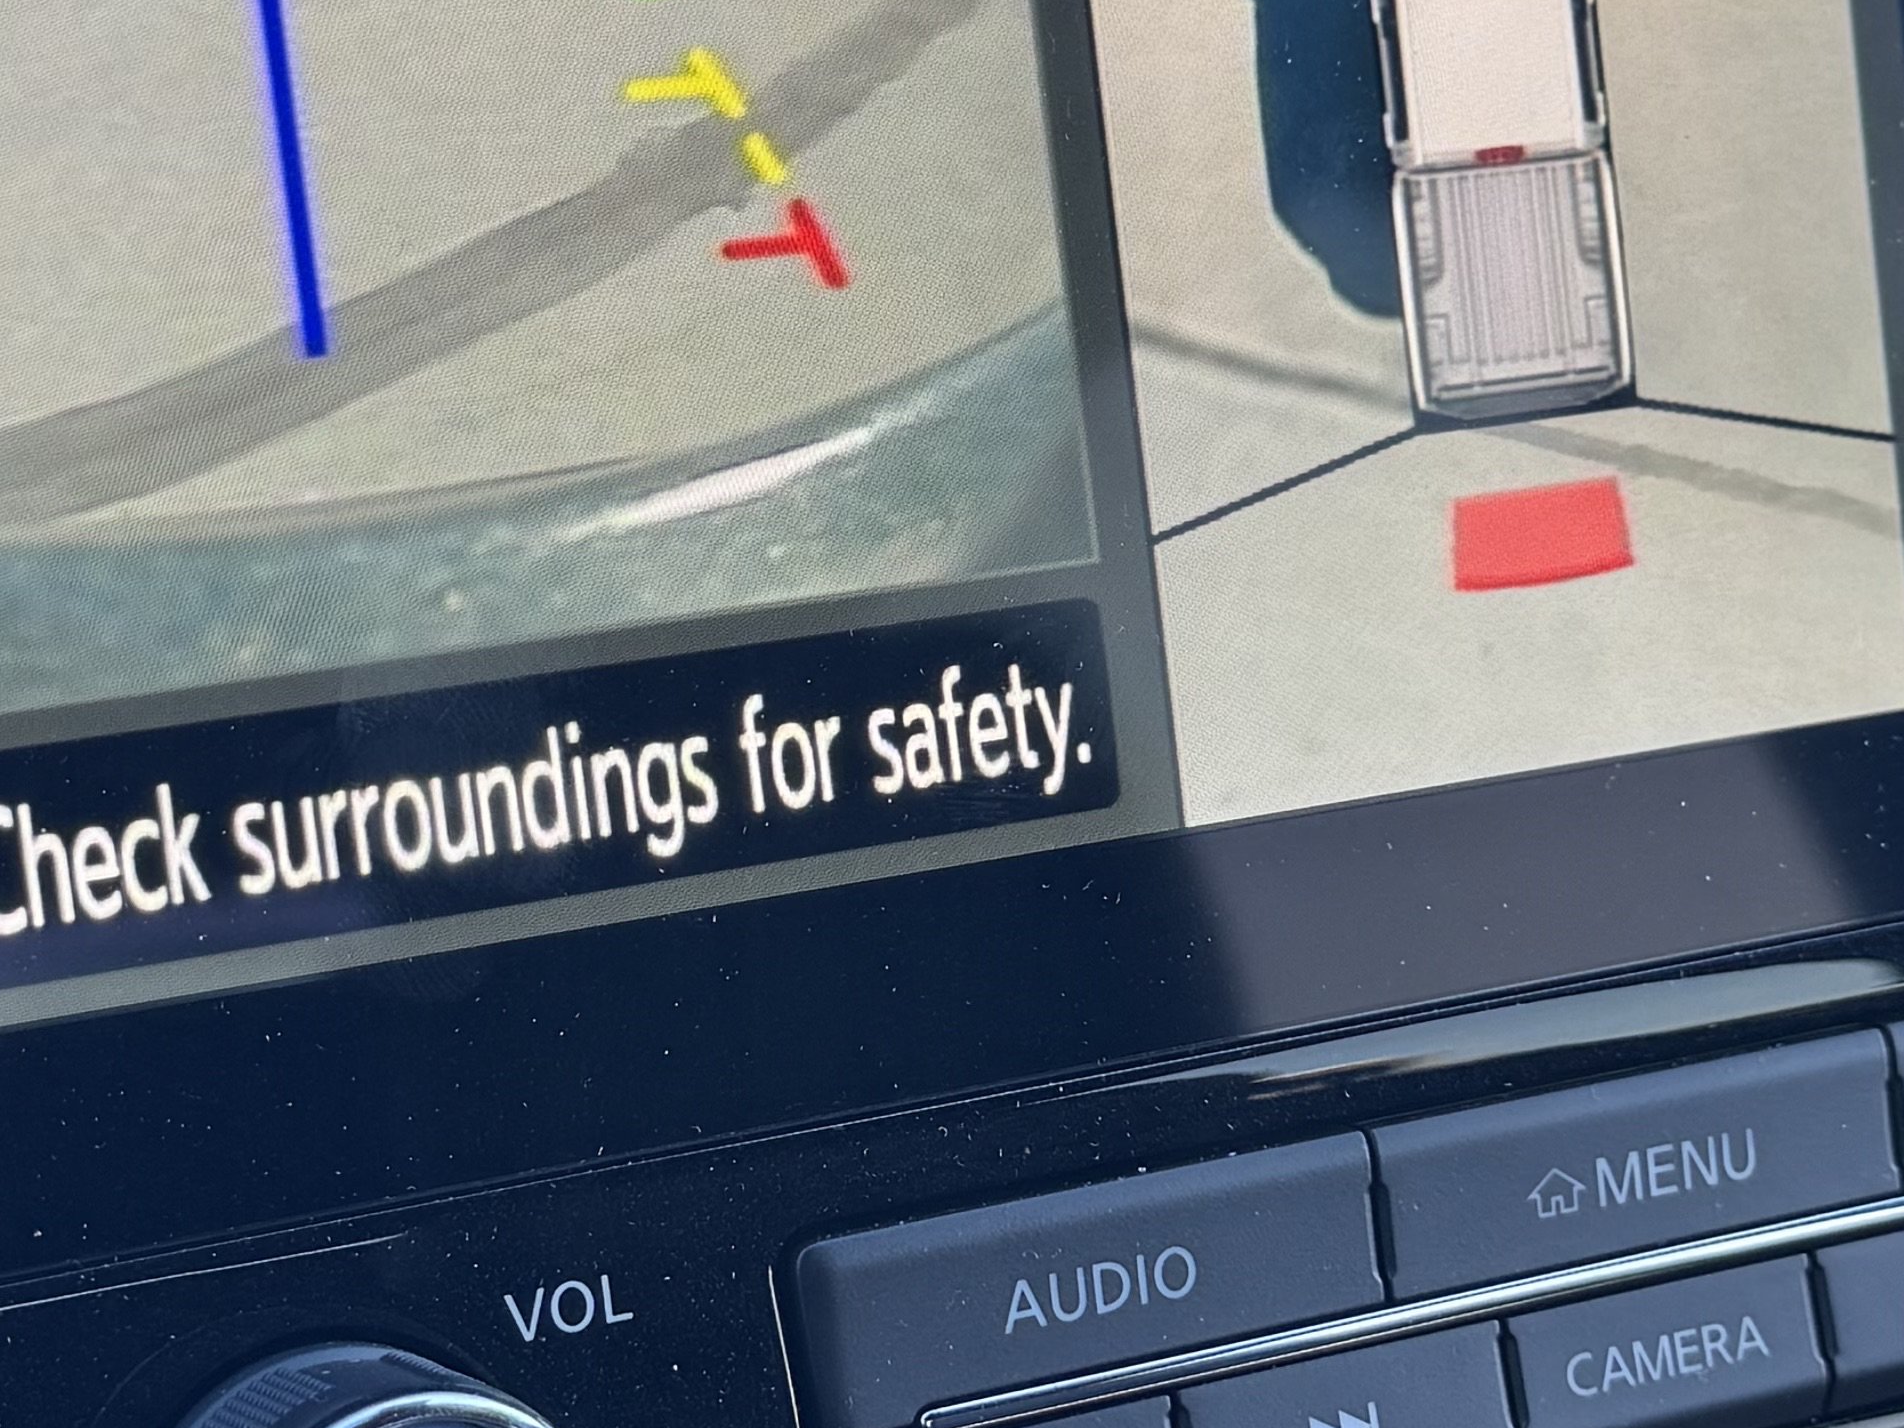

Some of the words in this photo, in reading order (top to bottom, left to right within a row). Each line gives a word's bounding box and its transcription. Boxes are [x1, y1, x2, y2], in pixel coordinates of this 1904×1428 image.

[238, 720, 718, 896] surroundings
[739, 691, 842, 817] for
[870, 662, 1094, 801] safety.
[1593, 1126, 1759, 1210] MENU
[503, 1272, 635, 1345] VOL
[1004, 1244, 1200, 1335] AUDIO
[1564, 1314, 1771, 1399] CAMERA
